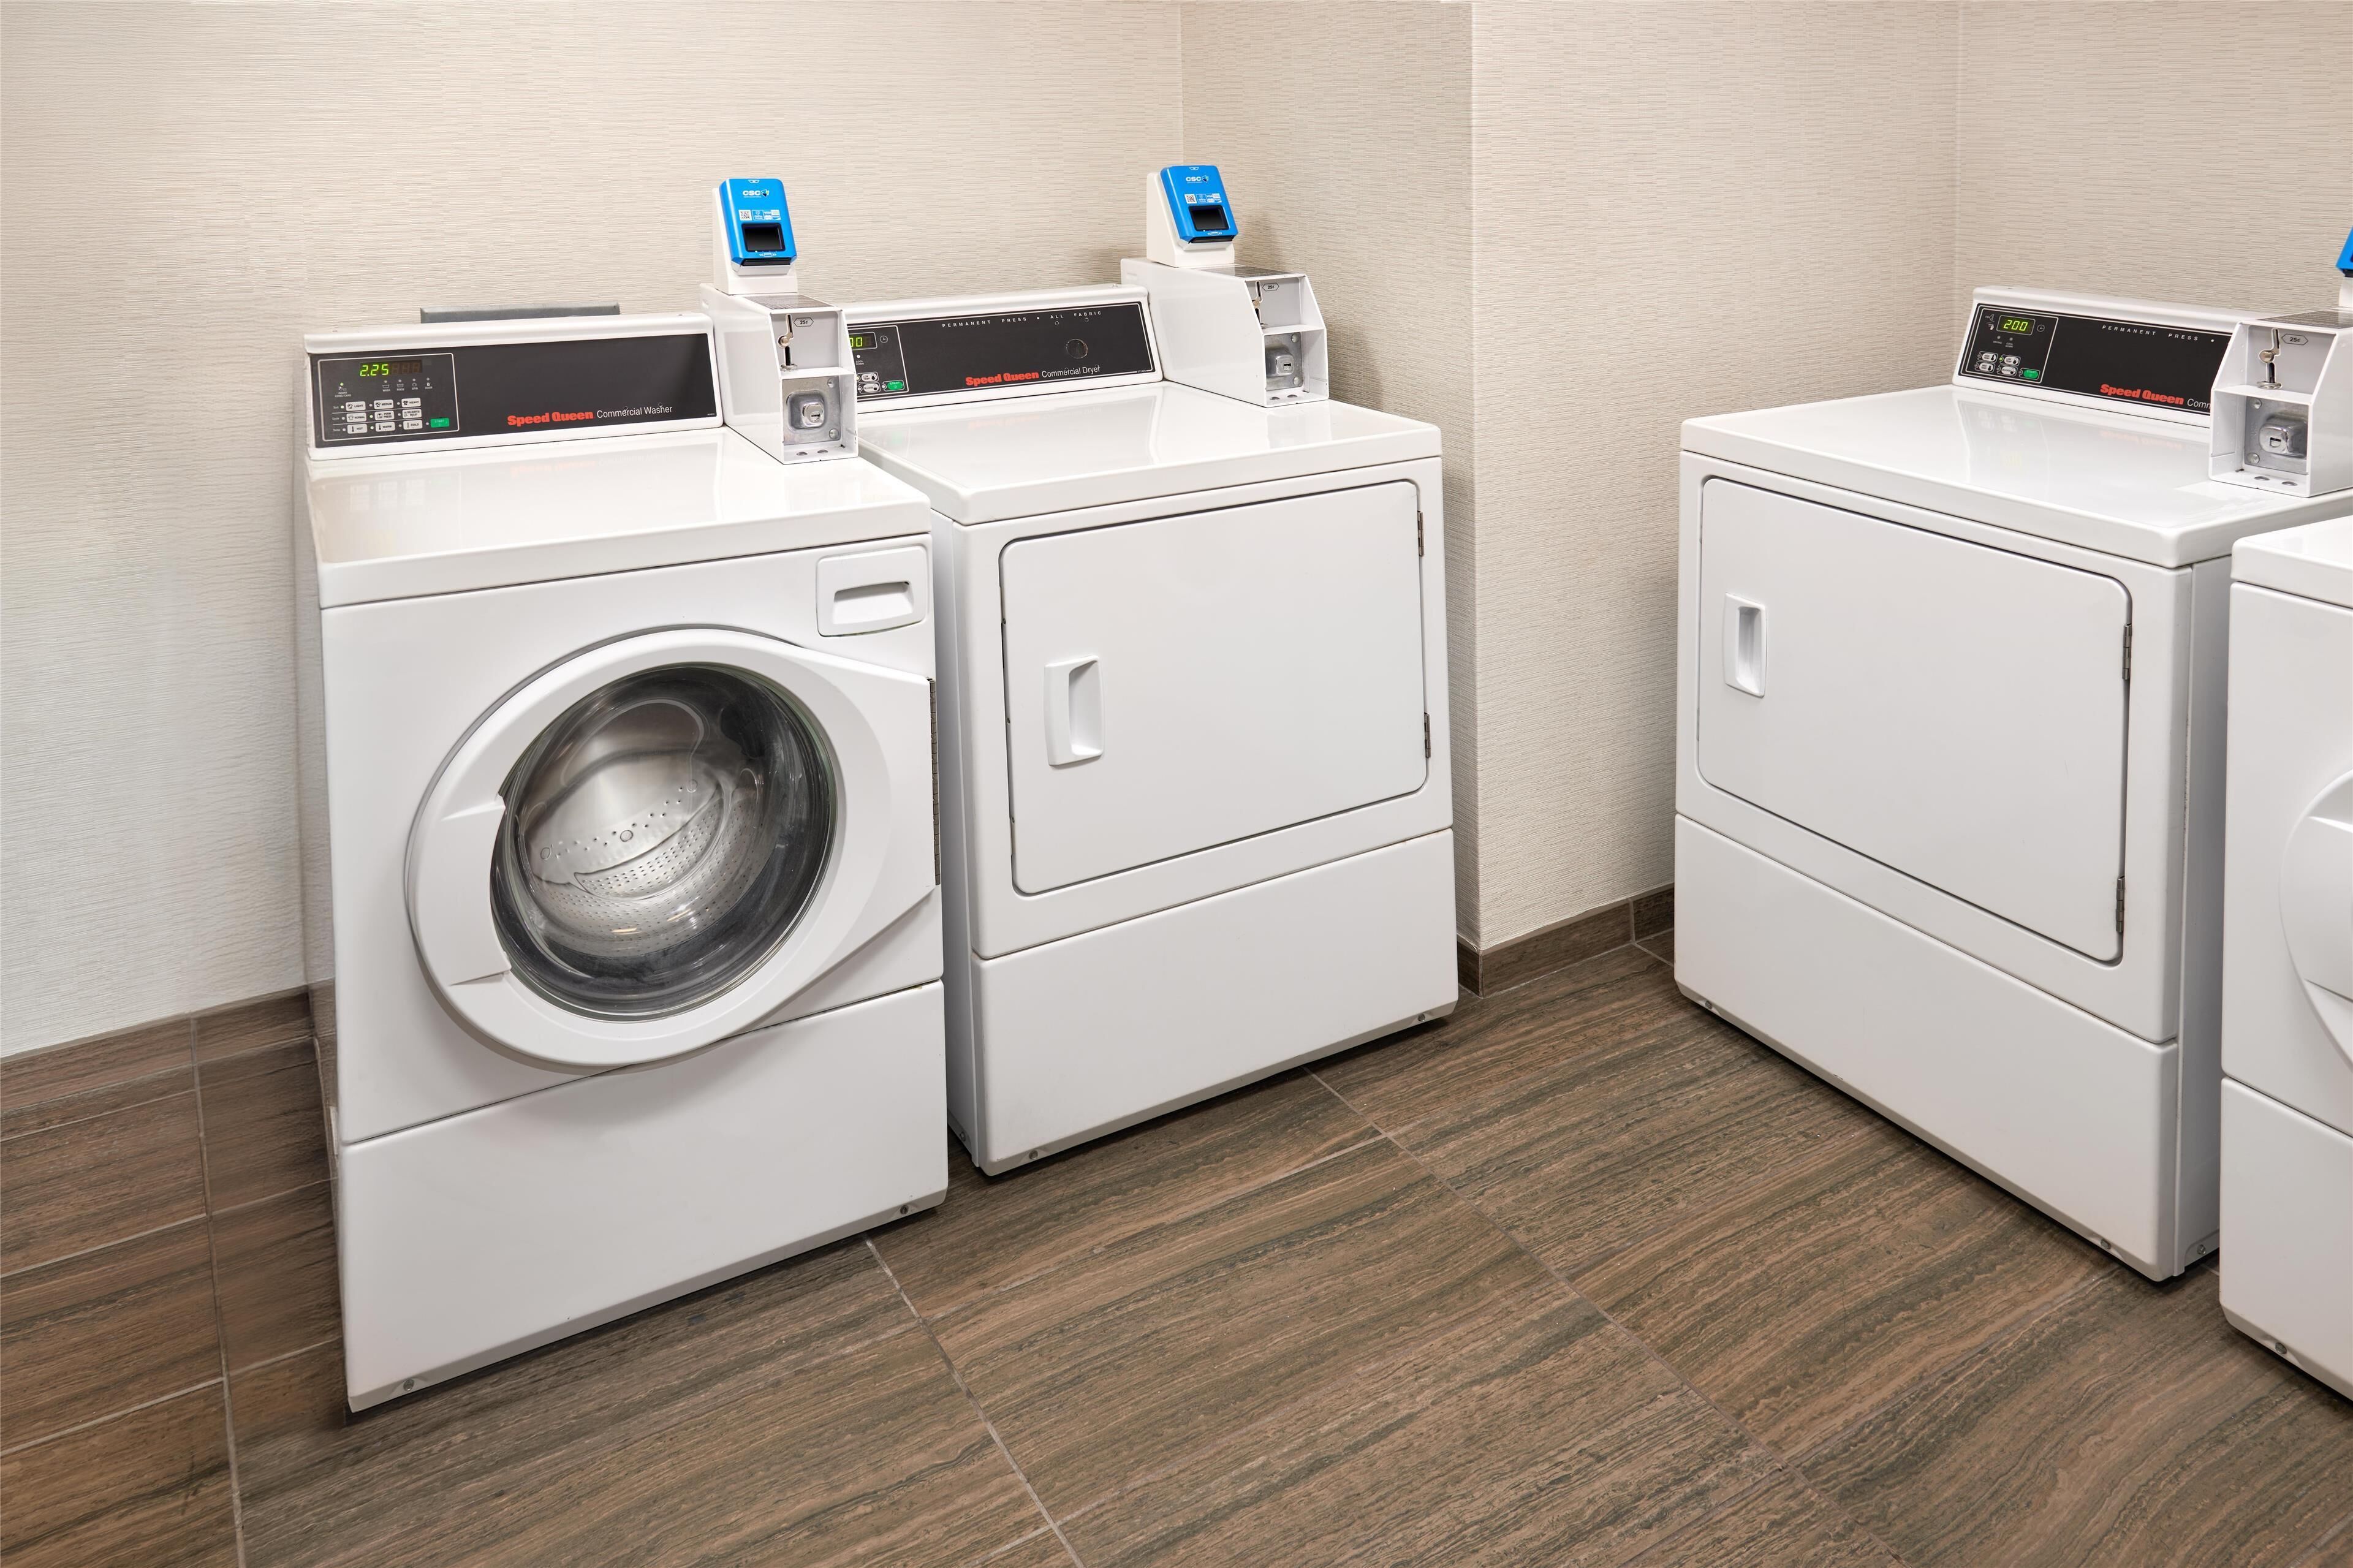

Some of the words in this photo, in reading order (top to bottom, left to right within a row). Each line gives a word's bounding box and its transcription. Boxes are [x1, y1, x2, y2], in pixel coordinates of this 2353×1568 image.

[942, 319, 991, 328] PERMANENT
[2003, 319, 2028, 331] 200
[2102, 325, 2157, 336] PERMANENT
[360, 364, 389, 377] 2.25
[965, 370, 1002, 386] Speed
[1003, 371, 1039, 382] Queen
[1041, 366, 1080, 378] Commercial
[1082, 366, 1101, 377] Dryer
[2100, 384, 2141, 396] Speed
[2142, 389, 2184, 405] Queen
[507, 412, 550, 426] Speed
[551, 411, 594, 422] Queen
[596, 407, 642, 419] Commercial
[643, 406, 673, 415] Washer
